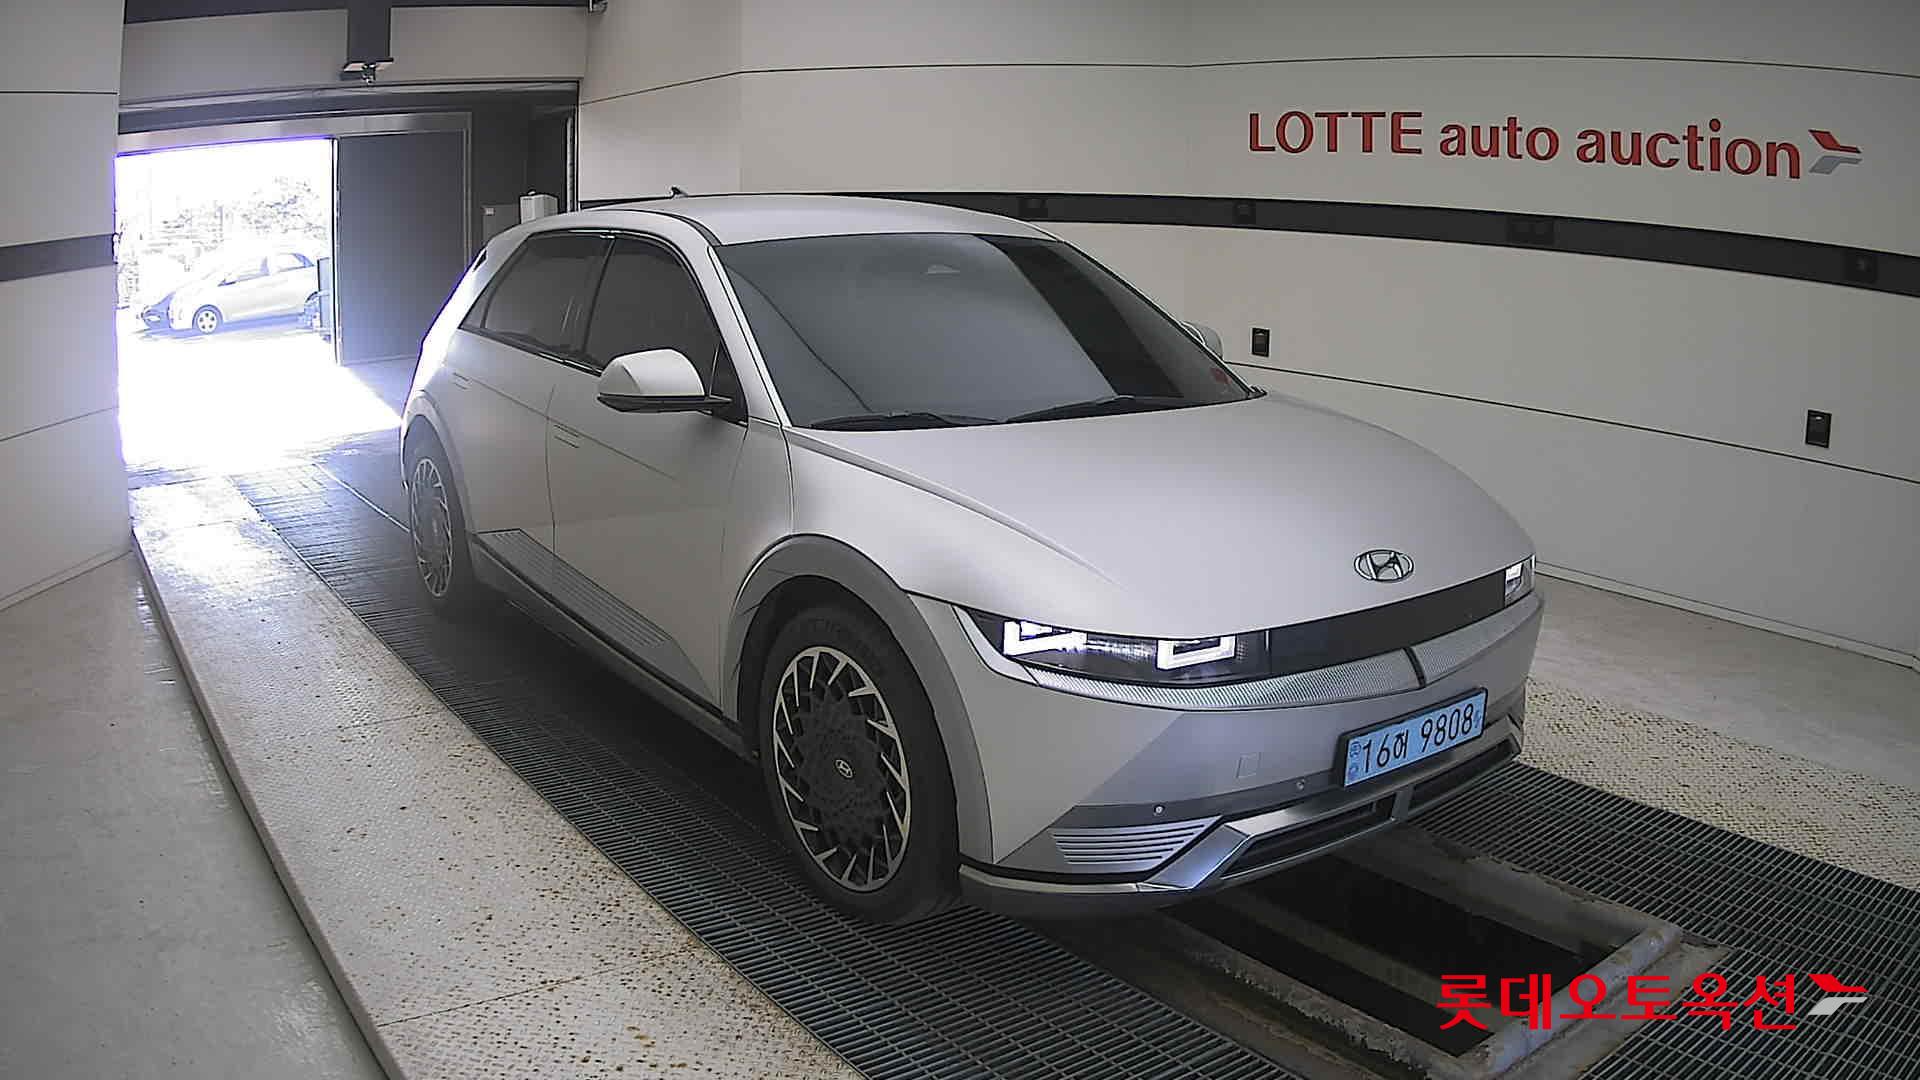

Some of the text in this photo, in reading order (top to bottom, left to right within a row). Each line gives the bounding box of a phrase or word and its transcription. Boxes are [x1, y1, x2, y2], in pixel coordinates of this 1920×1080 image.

[1248, 111, 1801, 179] LOTTE auto auction
[1421, 703, 1474, 753] 9808
